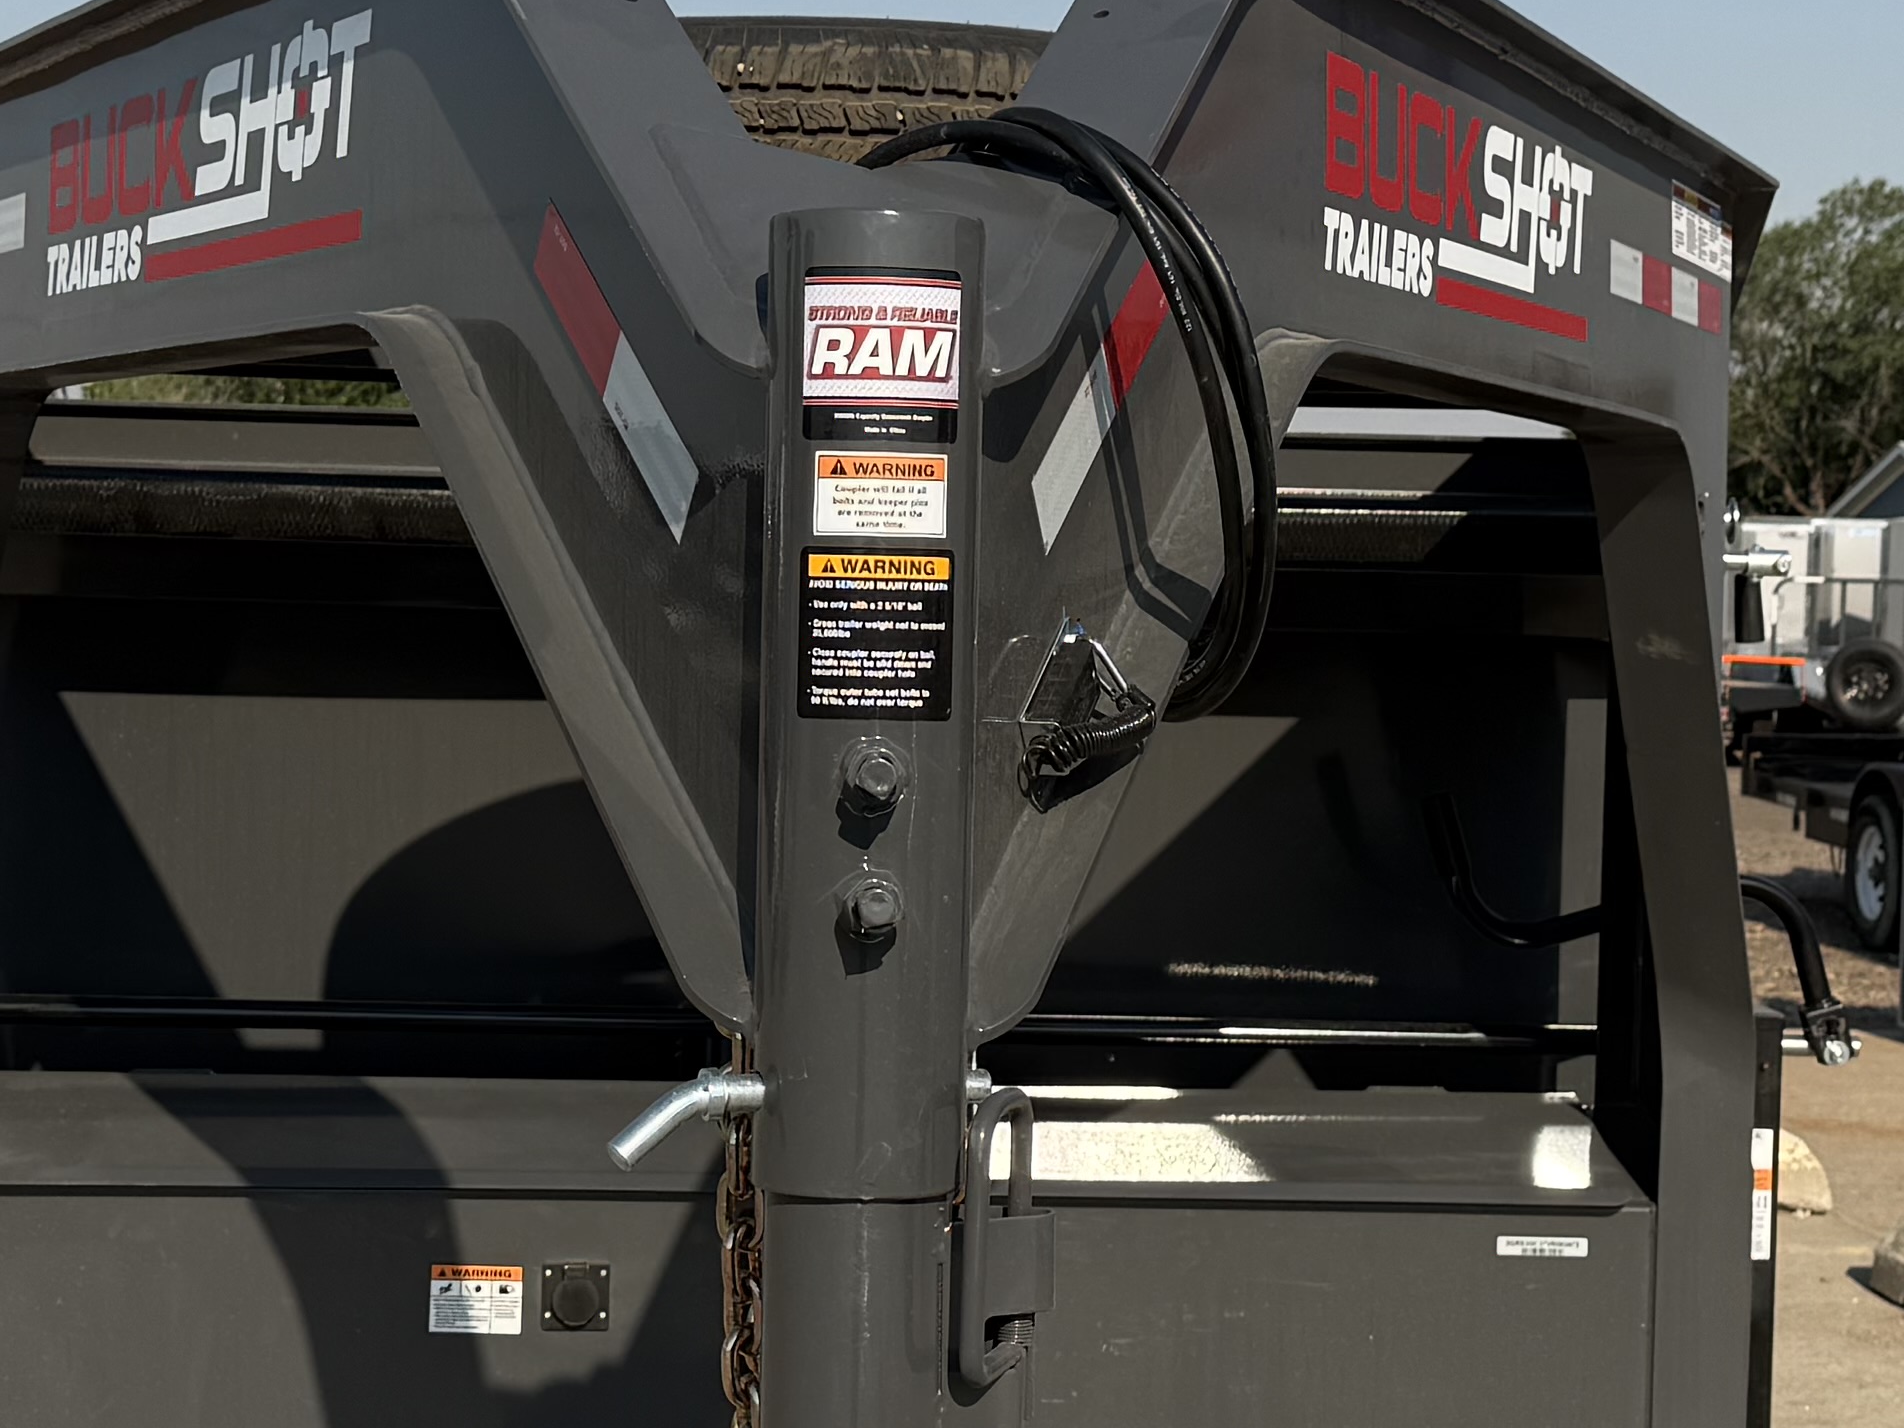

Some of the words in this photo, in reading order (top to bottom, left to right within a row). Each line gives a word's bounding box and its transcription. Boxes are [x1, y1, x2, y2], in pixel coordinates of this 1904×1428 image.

[47, 225, 144, 296] TRAILERS
[1324, 206, 1434, 298] TRAILERS
[811, 327, 954, 378] RAM
[853, 461, 936, 478] WARNING
[840, 558, 936, 576] WARNING
[451, 1267, 513, 1279] WARNING
